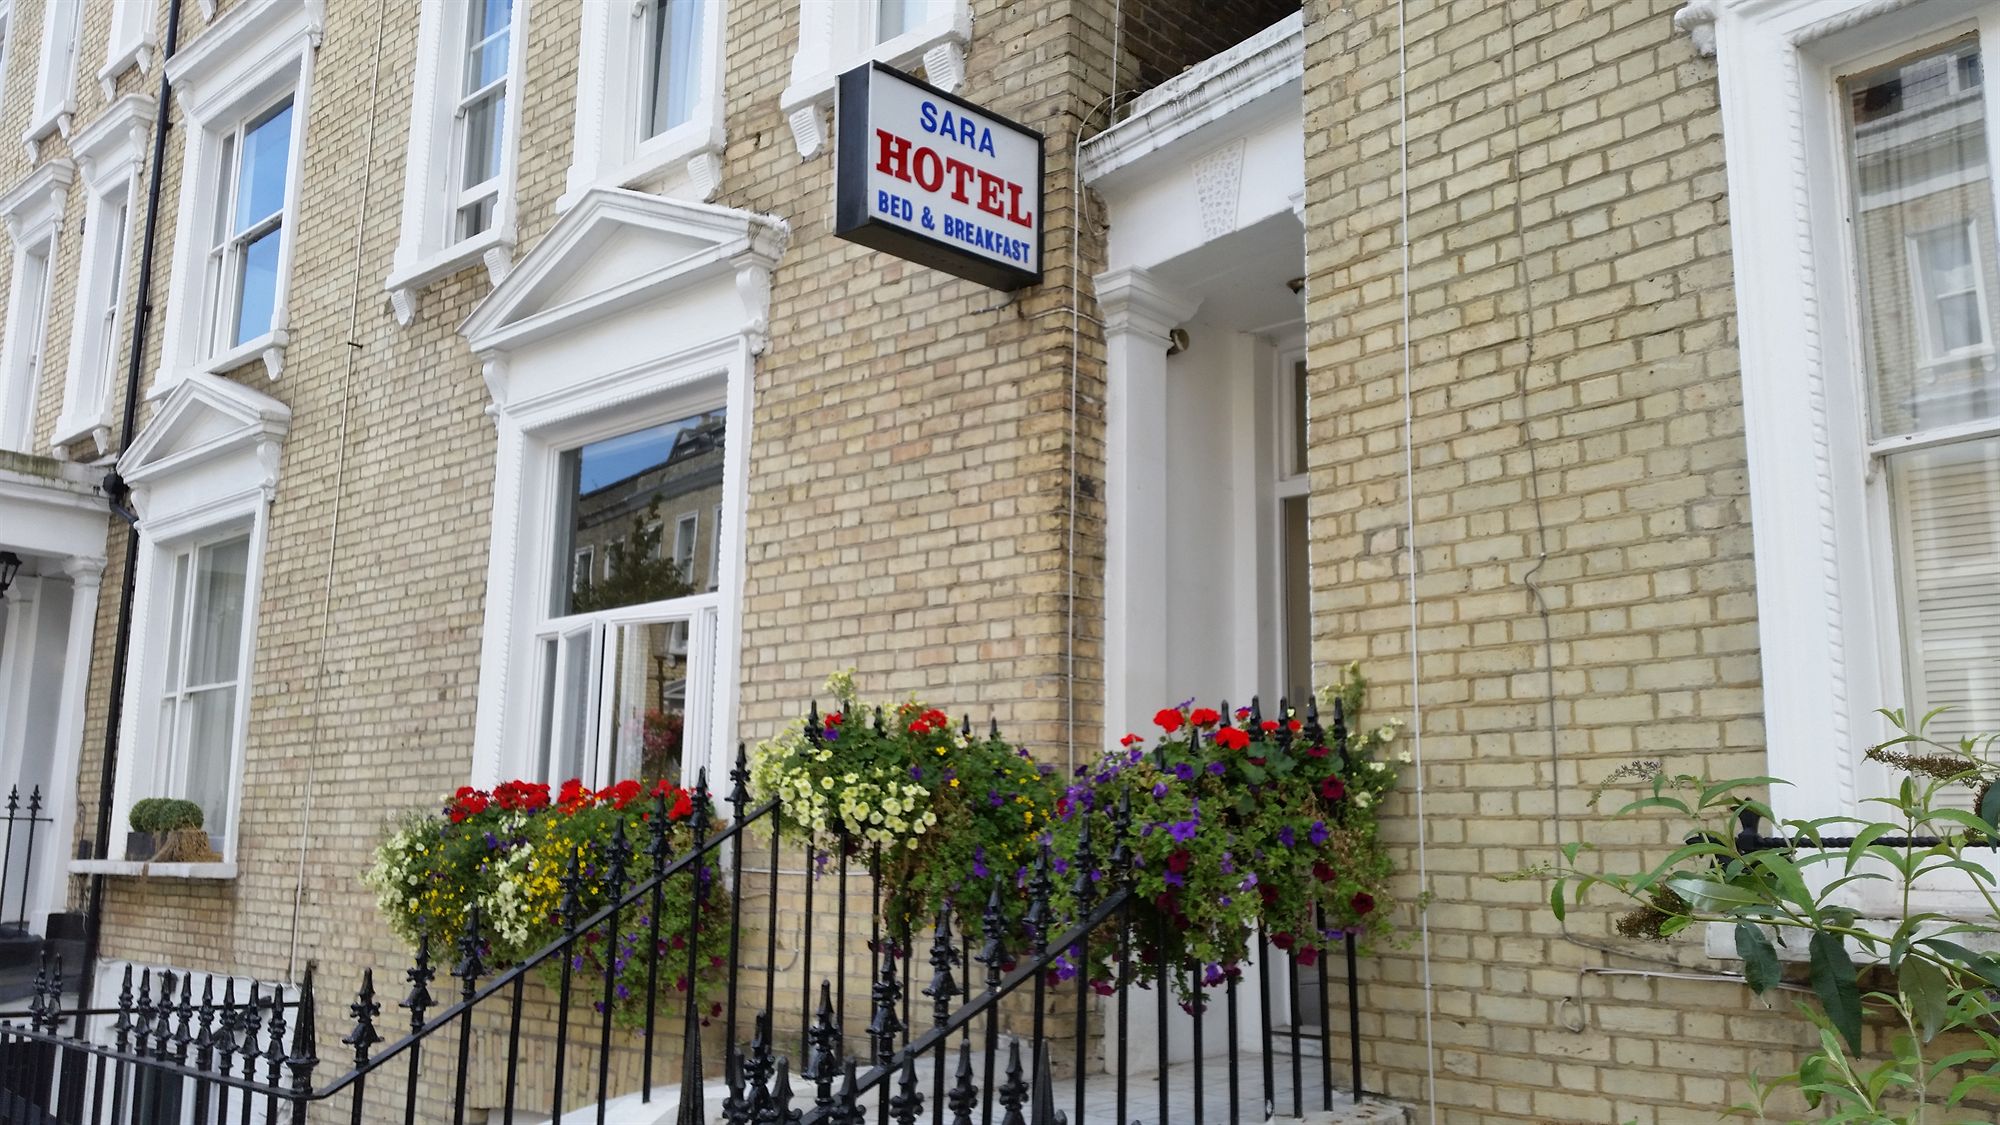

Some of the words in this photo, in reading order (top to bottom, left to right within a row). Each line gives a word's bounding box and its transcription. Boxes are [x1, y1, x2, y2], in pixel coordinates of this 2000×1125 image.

[920, 101, 996, 158] SARA
[876, 128, 1032, 229] HOTEL
[878, 190, 913, 222] BED
[921, 206, 936, 231] &
[944, 214, 1030, 263] BREAKFAST
